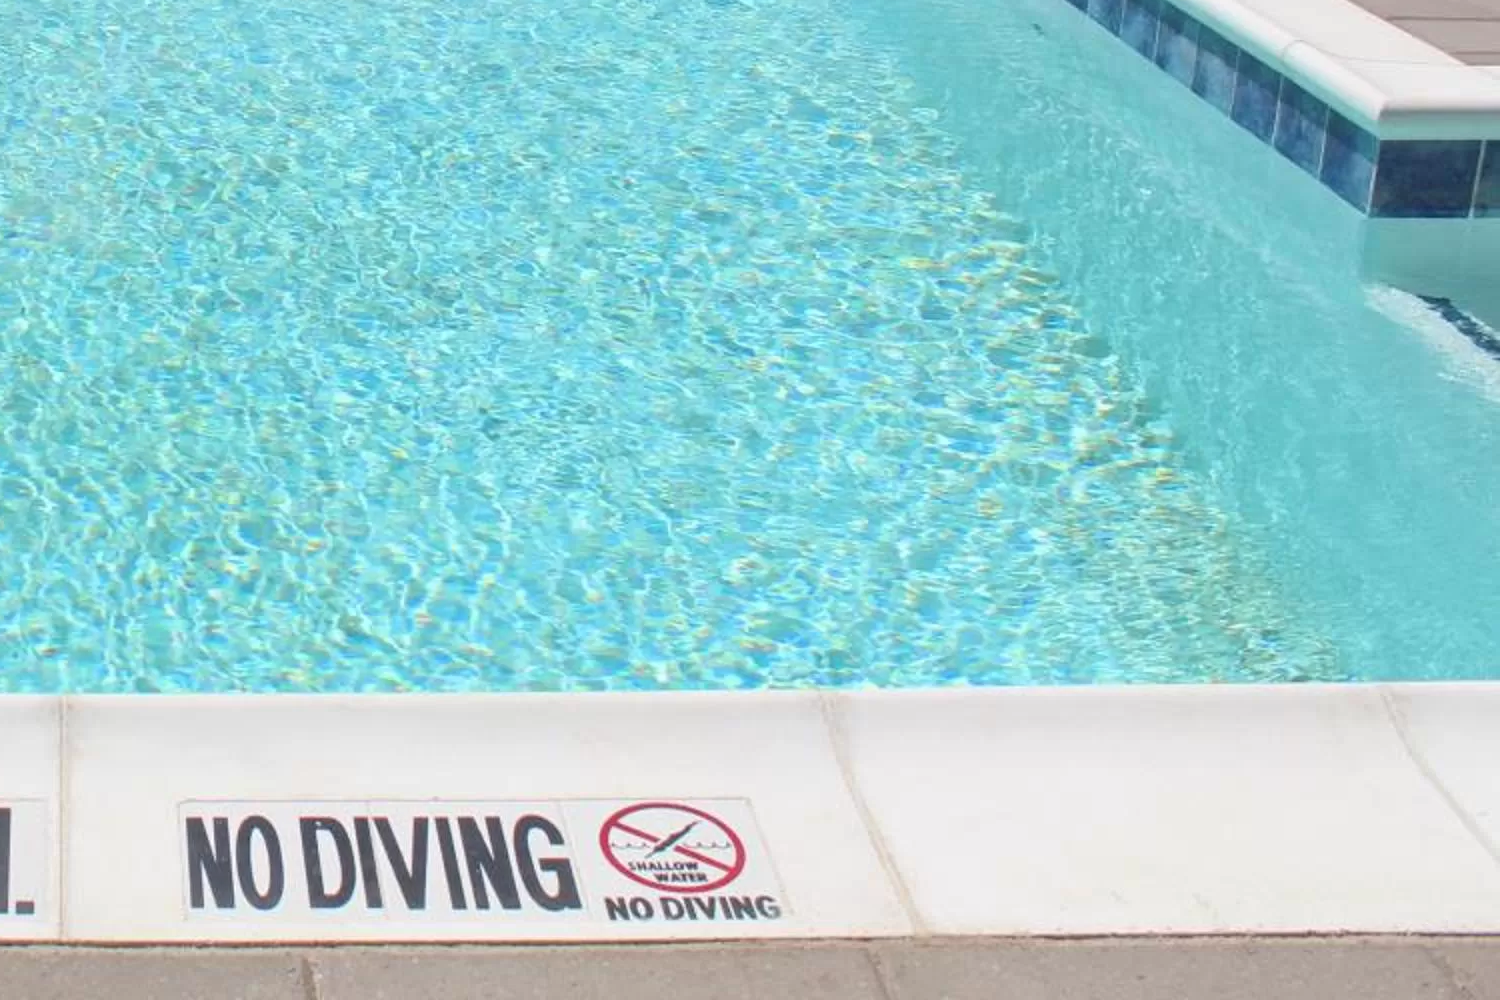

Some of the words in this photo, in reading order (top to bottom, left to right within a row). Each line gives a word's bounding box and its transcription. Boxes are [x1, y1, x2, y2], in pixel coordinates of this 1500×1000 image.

[185, 815, 284, 910] NO
[299, 815, 582, 911] DIVING
[628, 861, 699, 871] SHALLOW
[653, 872, 709, 883] WATER
[604, 896, 655, 921] NO
[659, 895, 782, 921] DIVING
